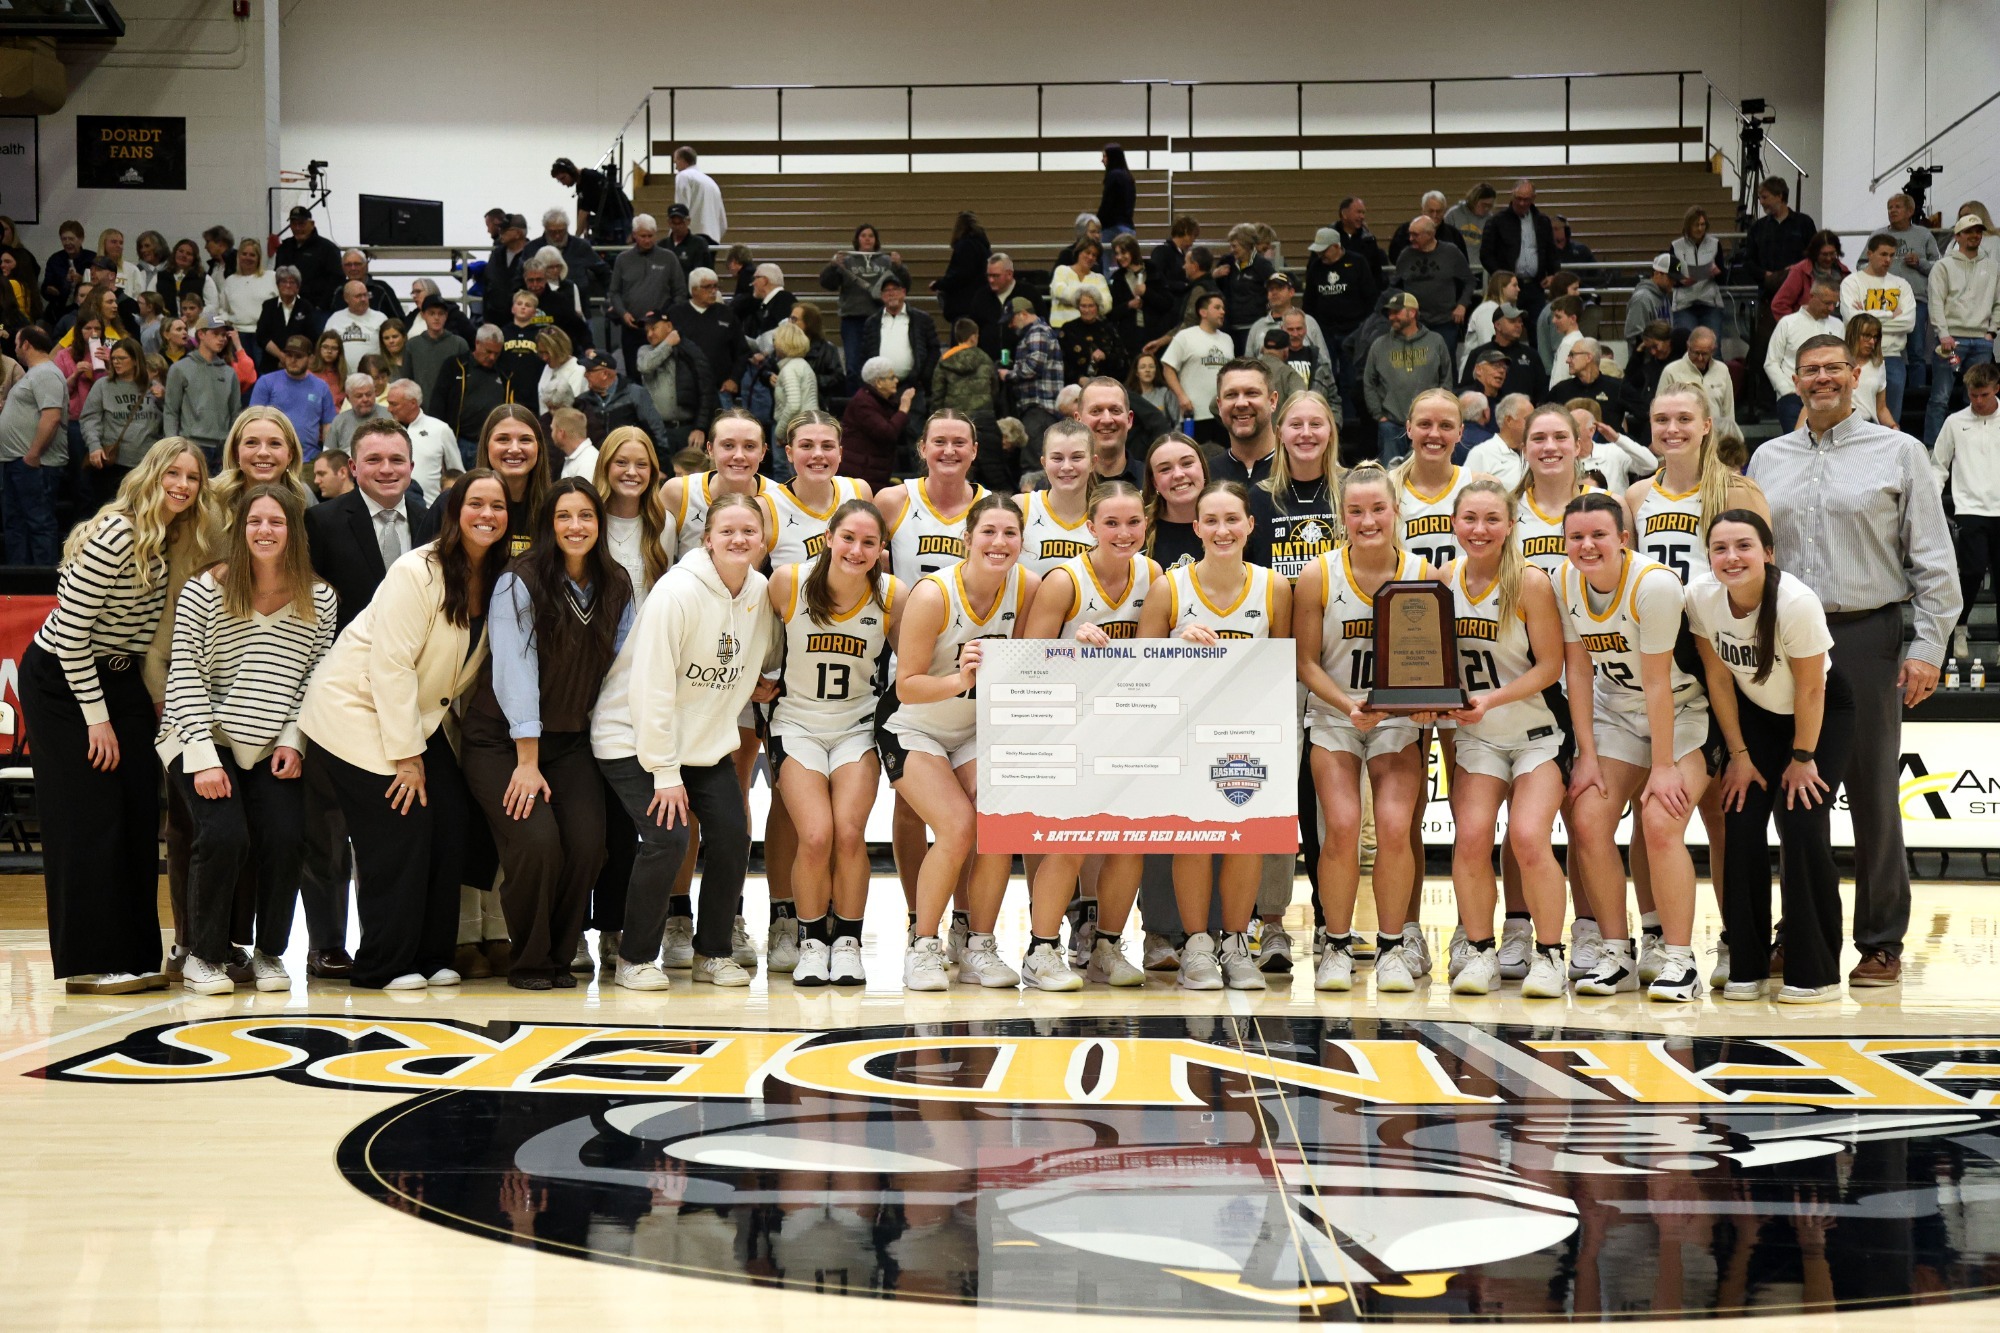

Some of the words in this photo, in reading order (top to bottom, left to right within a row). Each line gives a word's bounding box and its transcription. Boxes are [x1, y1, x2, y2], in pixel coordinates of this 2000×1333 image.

[101, 129, 162, 142] DORDT
[110, 146, 154, 159] FANS
[1318, 283, 1347, 292] DORDT
[1271, 515, 1290, 523] DORDT
[1290, 513, 1321, 521] UNIVERSITY
[1407, 516, 1451, 537] DORD
[1646, 514, 1700, 536] DORDT
[807, 634, 865, 656] DORDT
[1046, 648, 1075, 659] NAIA
[1081, 648, 1137, 658] NATIONAL
[1143, 648, 1228, 659] CHAMPIONSHIP
[1460, 650, 1501, 691] 21
[1601, 661, 1641, 691] 12
[816, 662, 850, 699] 13
[1212, 767, 1265, 778] BASKETBALL
[1046, 830, 1093, 842] BATTLE
[1095, 830, 1120, 842] FOR
[1122, 830, 1148, 842] THE
[1148, 830, 1172, 842] RED
[1174, 830, 1227, 842] BANNER
